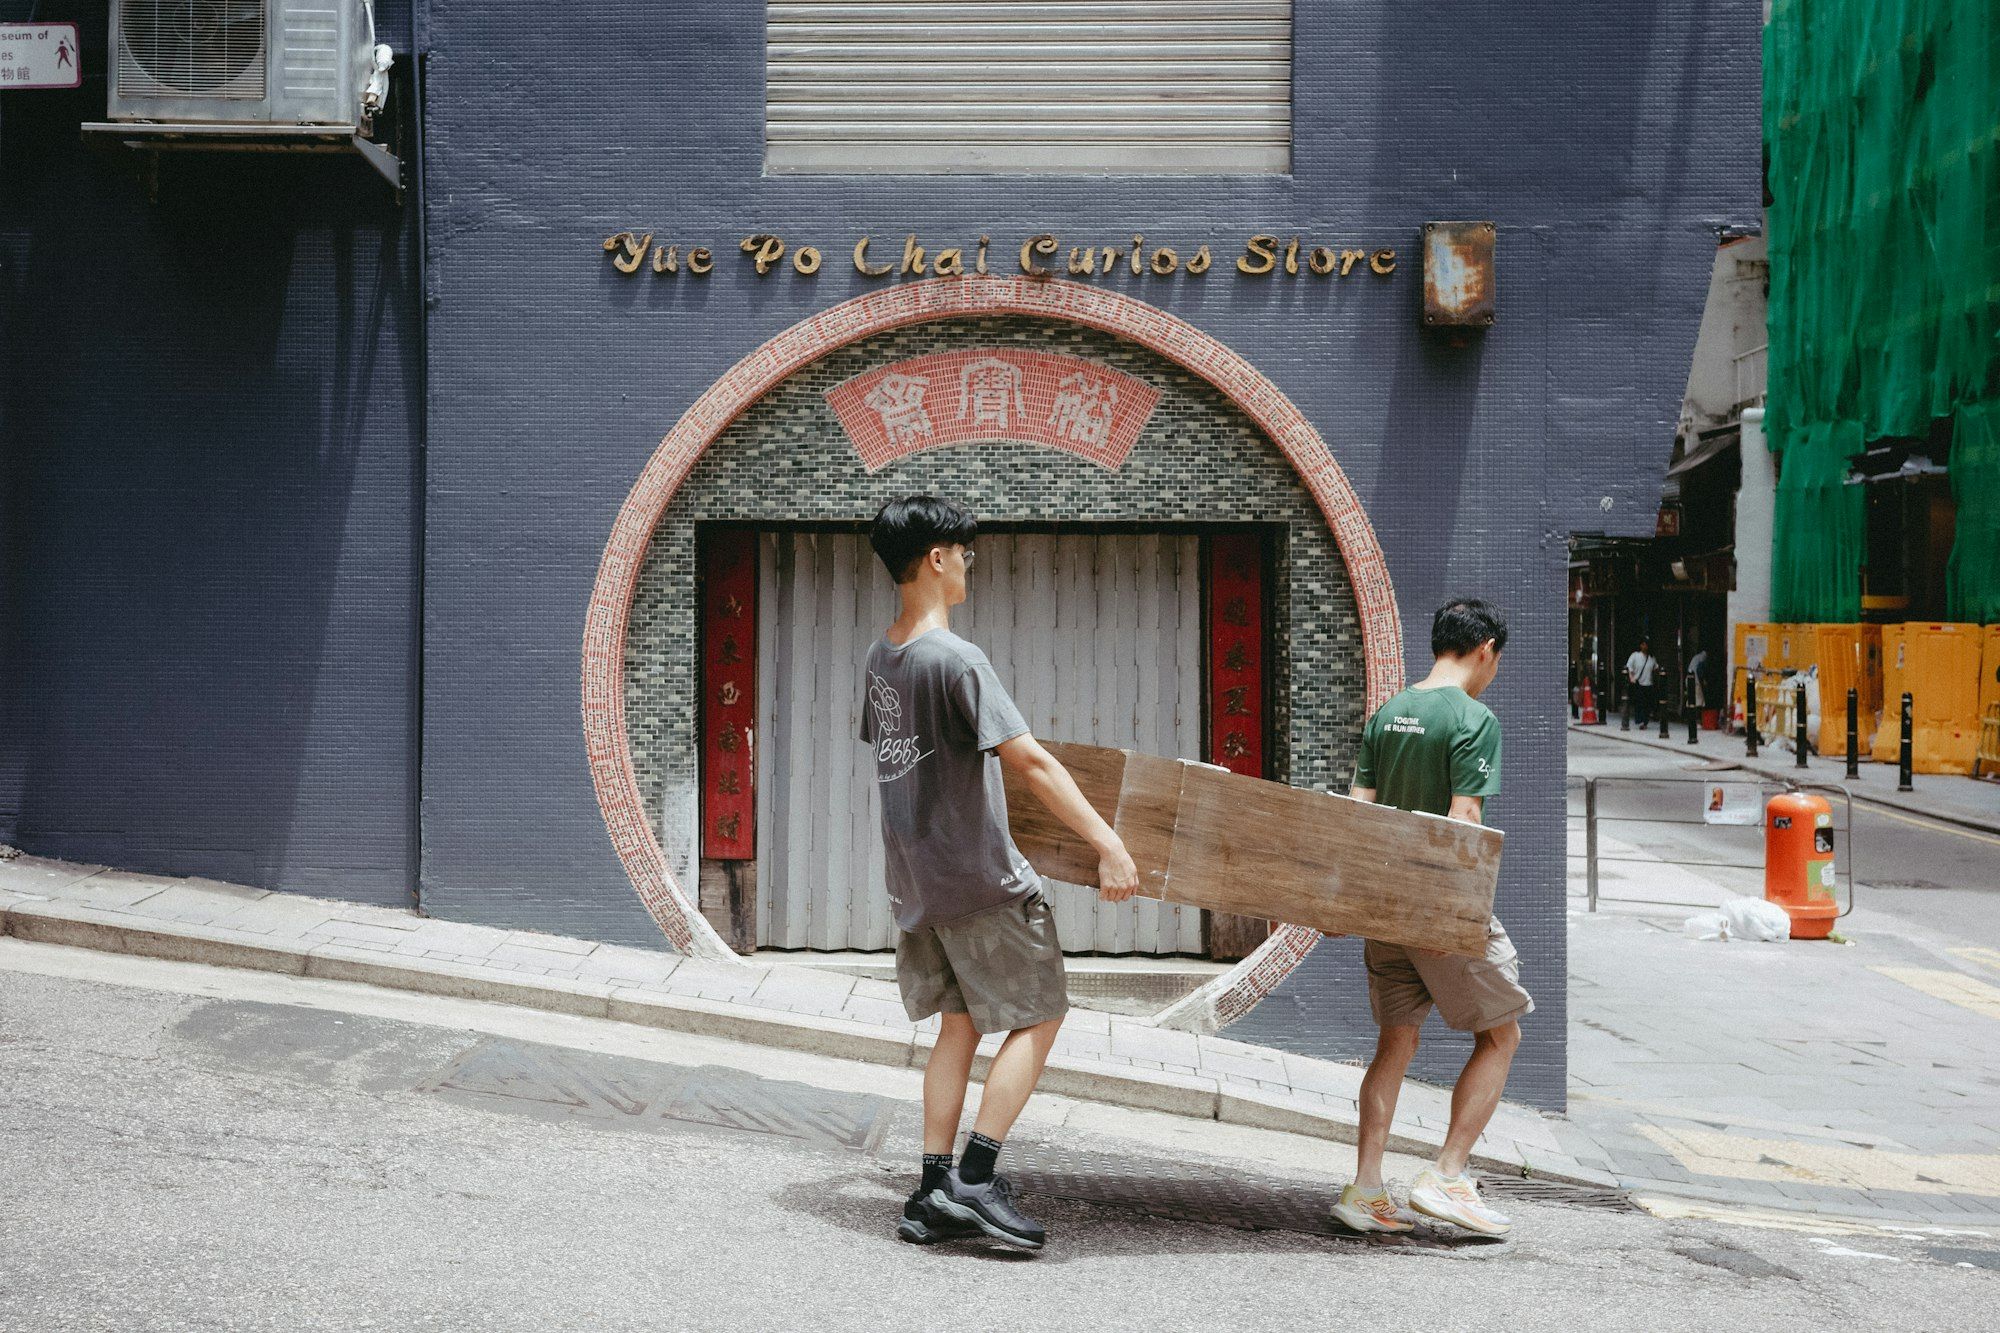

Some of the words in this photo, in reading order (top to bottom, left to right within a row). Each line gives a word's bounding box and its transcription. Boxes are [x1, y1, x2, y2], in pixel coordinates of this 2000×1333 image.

[37, 30, 49, 40] of
[1, 51, 14, 61] es
[1, 66, 30, 81] 物館
[602, 231, 714, 274] Yue
[739, 233, 823, 275] Po
[853, 232, 990, 276] Chai
[1019, 232, 1211, 276] Curios
[1236, 233, 1398, 276] Store
